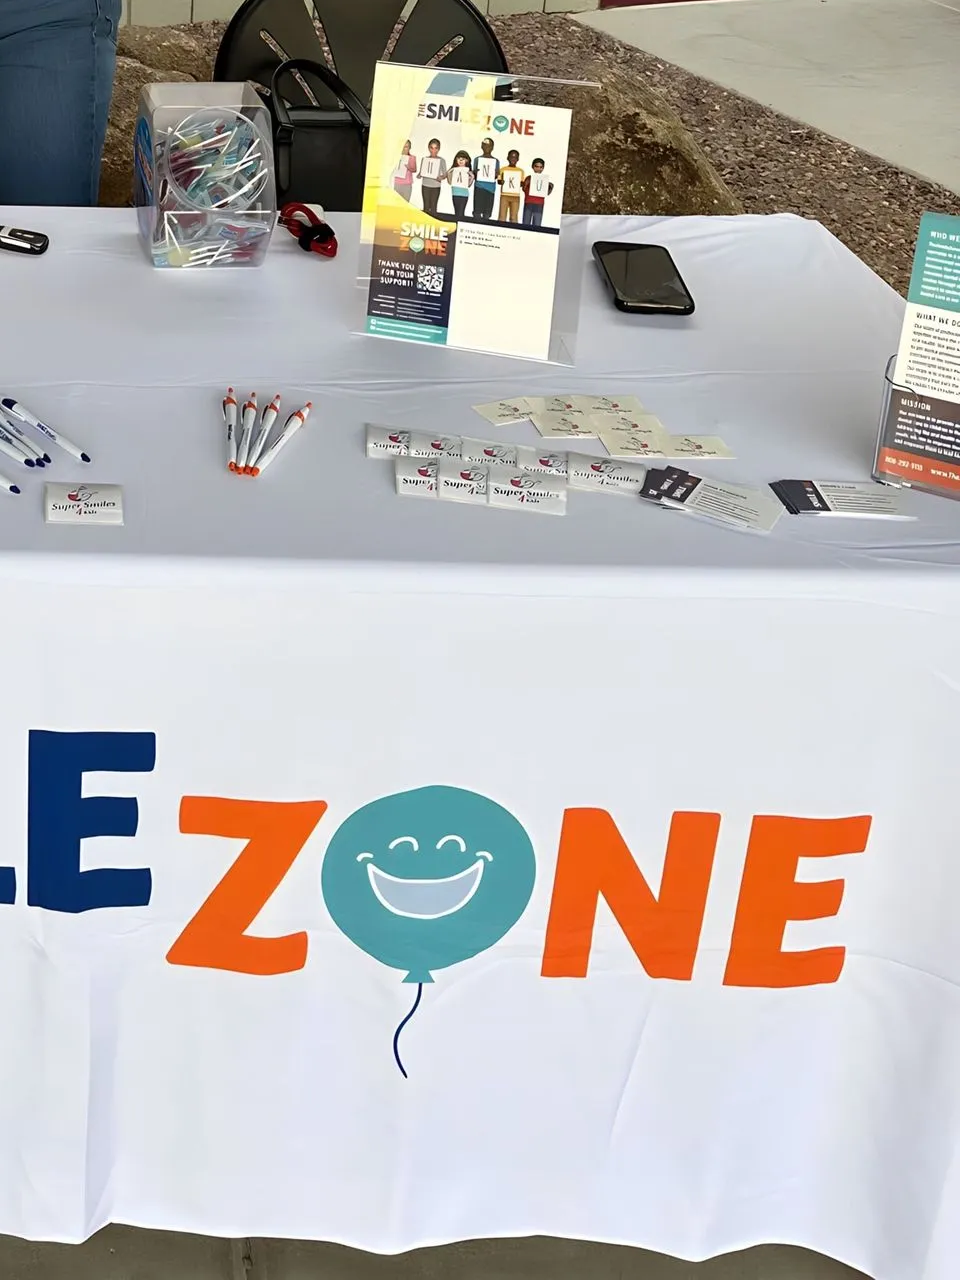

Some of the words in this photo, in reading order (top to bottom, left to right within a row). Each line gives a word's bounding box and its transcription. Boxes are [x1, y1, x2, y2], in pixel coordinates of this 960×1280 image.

[400, 221, 449, 241] SMILE
[399, 235, 447, 256] ZONE
[378, 259, 400, 269] THANK
[401, 262, 415, 271] YOU
[381, 267, 395, 276] FOR
[396, 270, 414, 279] YOUR
[916, 311, 936, 322] WHAT
[901, 398, 932, 411] MISSION
[373, 442, 400, 451] Super
[414, 449, 443, 458] Super
[468, 456, 496, 465] Super
[402, 477, 431, 487] Super
[573, 470, 602, 479] Super
[607, 474, 639, 483] Smiles
[443, 479, 472, 489] Super
[493, 486, 523, 496] Super
[526, 490, 560, 499] Smiles
[51, 503, 80, 512] Super
[83, 500, 116, 508] Smiles
[165, 784, 873, 989] ZONE
